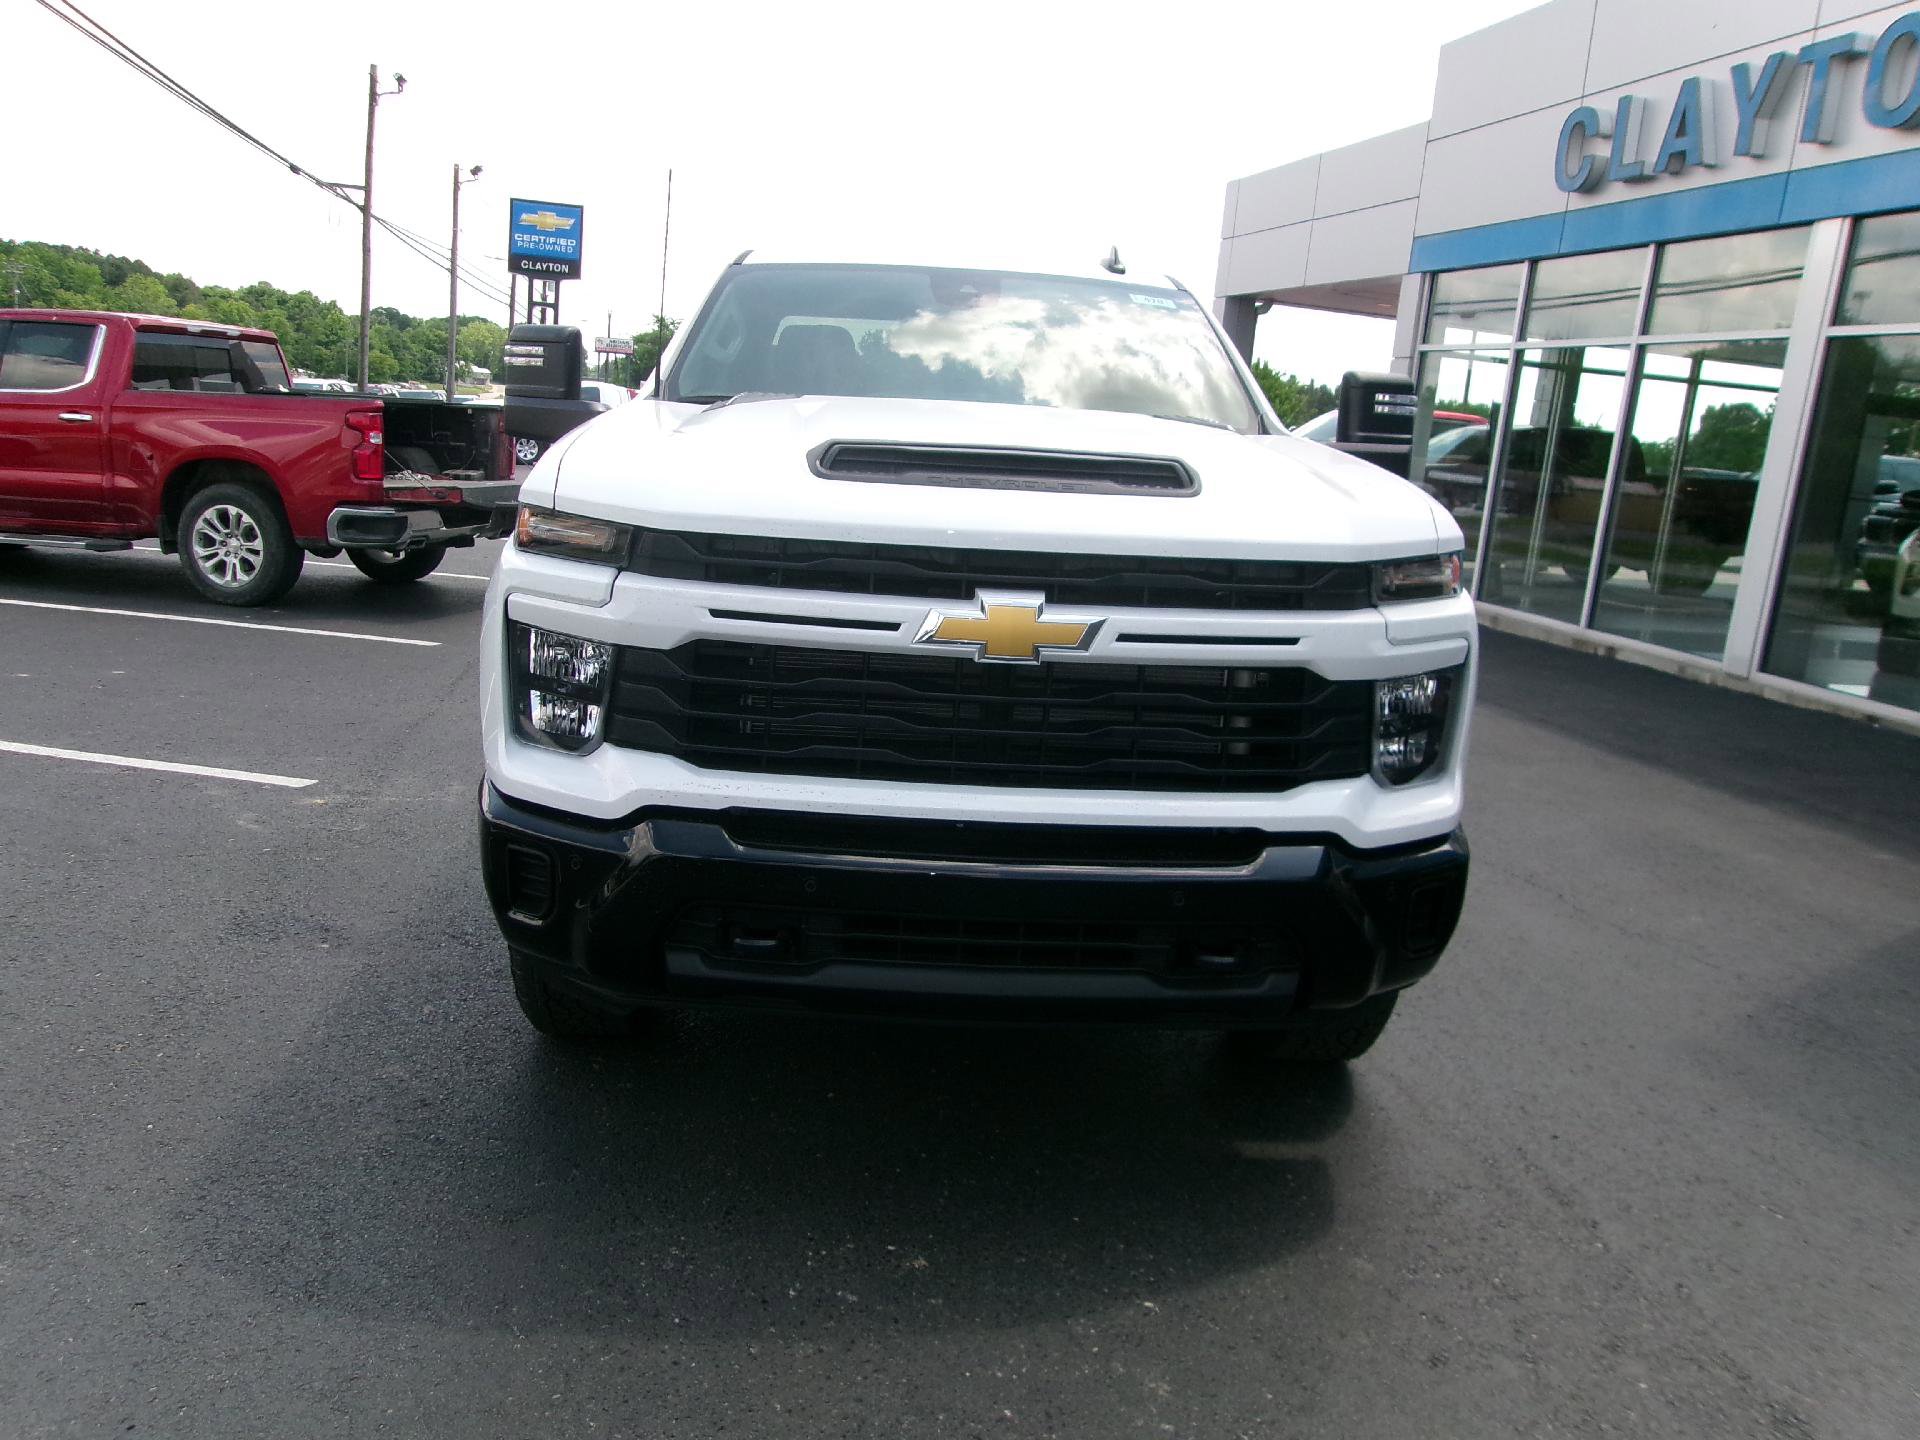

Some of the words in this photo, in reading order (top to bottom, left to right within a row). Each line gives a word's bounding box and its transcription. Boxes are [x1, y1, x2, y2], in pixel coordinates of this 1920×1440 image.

[514, 233, 576, 246] CERTIFIED
[517, 240, 573, 253] PRE-OWNED
[521, 260, 569, 273] CLAYTON
[926, 475, 1092, 492] CHEVROLET
